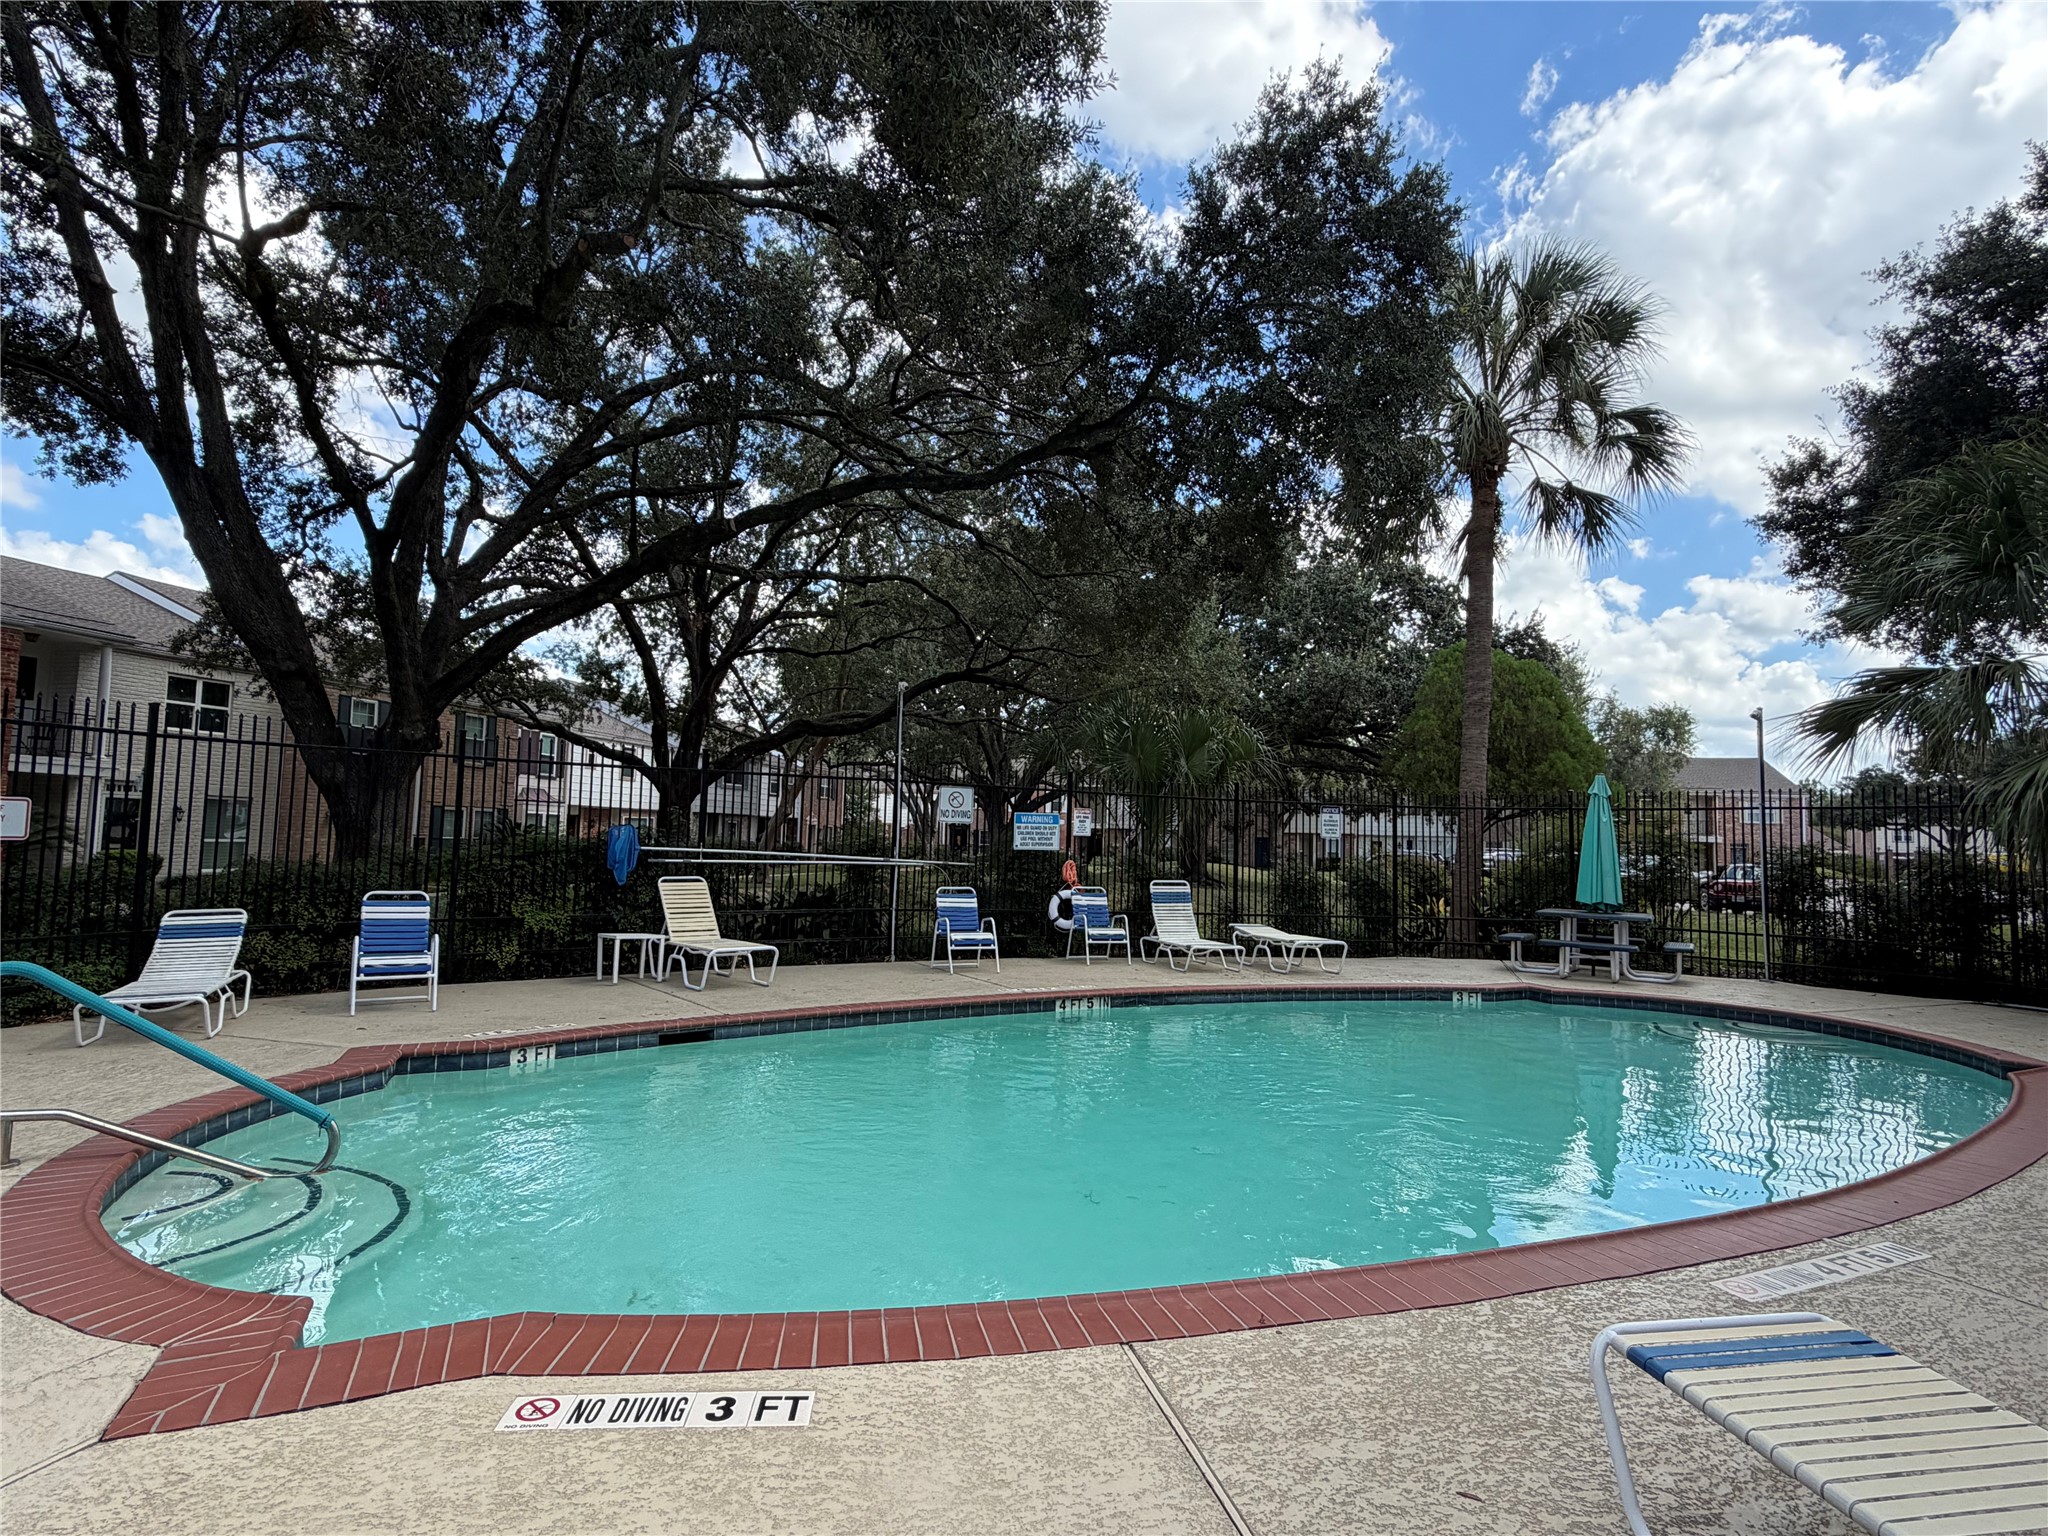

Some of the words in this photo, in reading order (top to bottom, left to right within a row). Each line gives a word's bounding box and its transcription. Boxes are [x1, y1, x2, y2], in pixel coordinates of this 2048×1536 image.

[940, 810, 950, 818] NO
[951, 810, 971, 819] DIVING
[1021, 815, 1053, 823] WARNING
[1060, 999, 1066, 1010] 4
[1071, 998, 1082, 1010] FT
[1087, 998, 1094, 1009] 5
[1099, 996, 1109, 1008] IN
[1457, 992, 1463, 1001] 3
[1468, 992, 1480, 1001] FT
[517, 1048, 527, 1063] 3
[535, 1045, 553, 1060] FT
[1855, 1250, 1895, 1264] 5
[1875, 1244, 1923, 1259] IN
[1810, 1262, 1847, 1276] 4
[1826, 1255, 1873, 1272] FT
[566, 1398, 606, 1424] NO
[608, 1396, 689, 1423] DIVING
[705, 1396, 737, 1422] 3
[754, 1396, 809, 1422] FT
